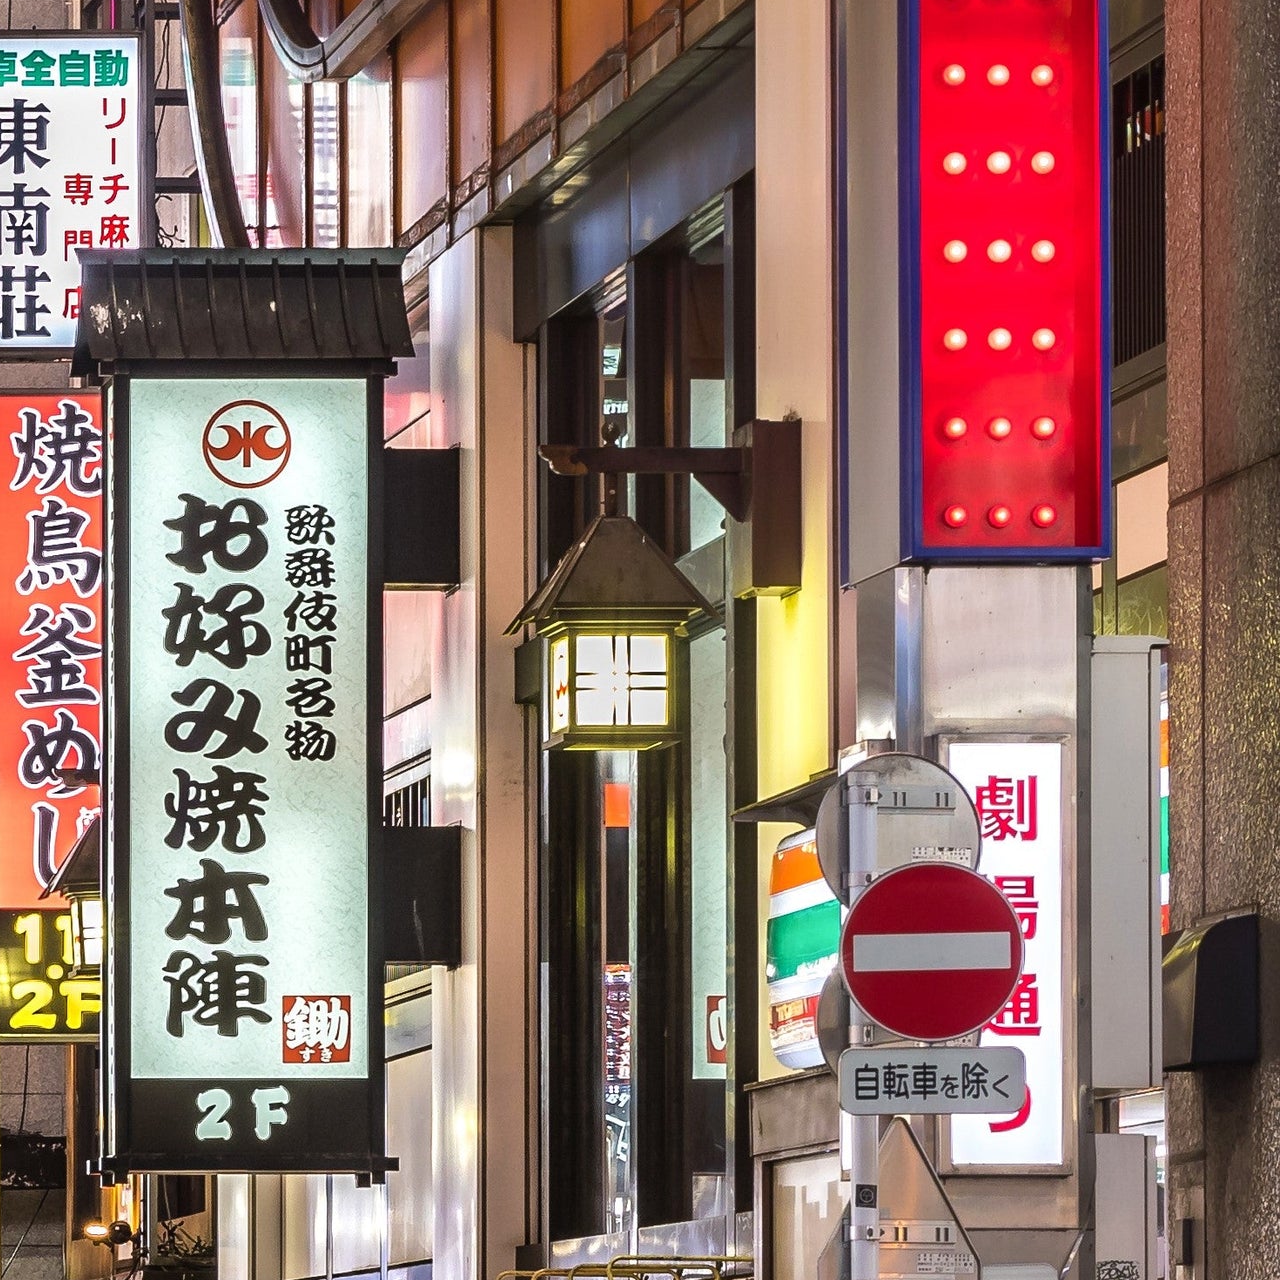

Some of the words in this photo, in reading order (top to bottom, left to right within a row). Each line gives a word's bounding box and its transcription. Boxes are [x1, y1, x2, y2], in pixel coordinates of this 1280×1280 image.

[282, 502, 338, 763] 歌舞伎町名物
[162, 493, 274, 1040] お好み焼本陣
[299, 1047, 333, 1063] すき
[854, 1061, 1011, 1102] 自転車を除く
[195, 1087, 291, 1142] 2F
